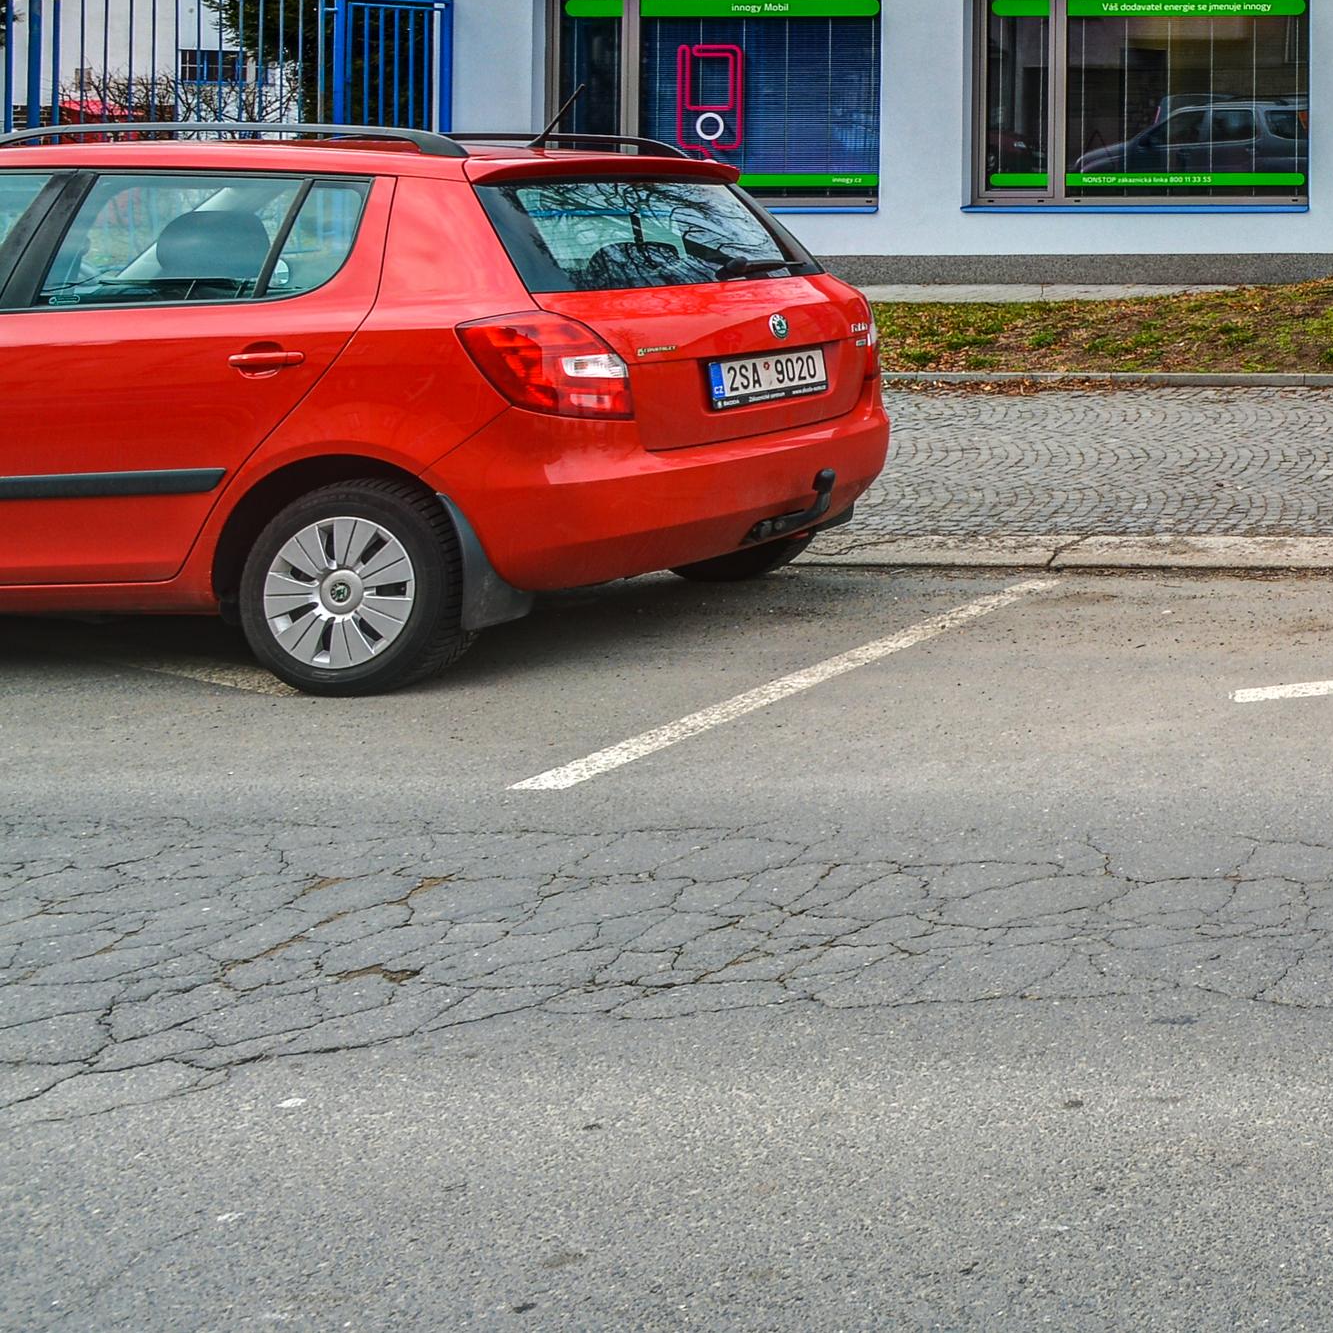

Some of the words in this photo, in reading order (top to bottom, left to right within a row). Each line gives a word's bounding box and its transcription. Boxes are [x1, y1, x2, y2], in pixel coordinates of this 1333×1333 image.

[731, 3, 762, 13] innogy
[764, 3, 789, 12] Mobil
[1102, 1, 1119, 12] Váš
[1120, 2, 1162, 12] dodavatel
[1164, 3, 1195, 13] energie
[1208, 3, 1241, 13] jmenuje
[1243, 2, 1272, 13] innogy
[727, 362, 762, 392] 2SA
[774, 355, 817, 384] 9020
[714, 386, 725, 394] CZ
